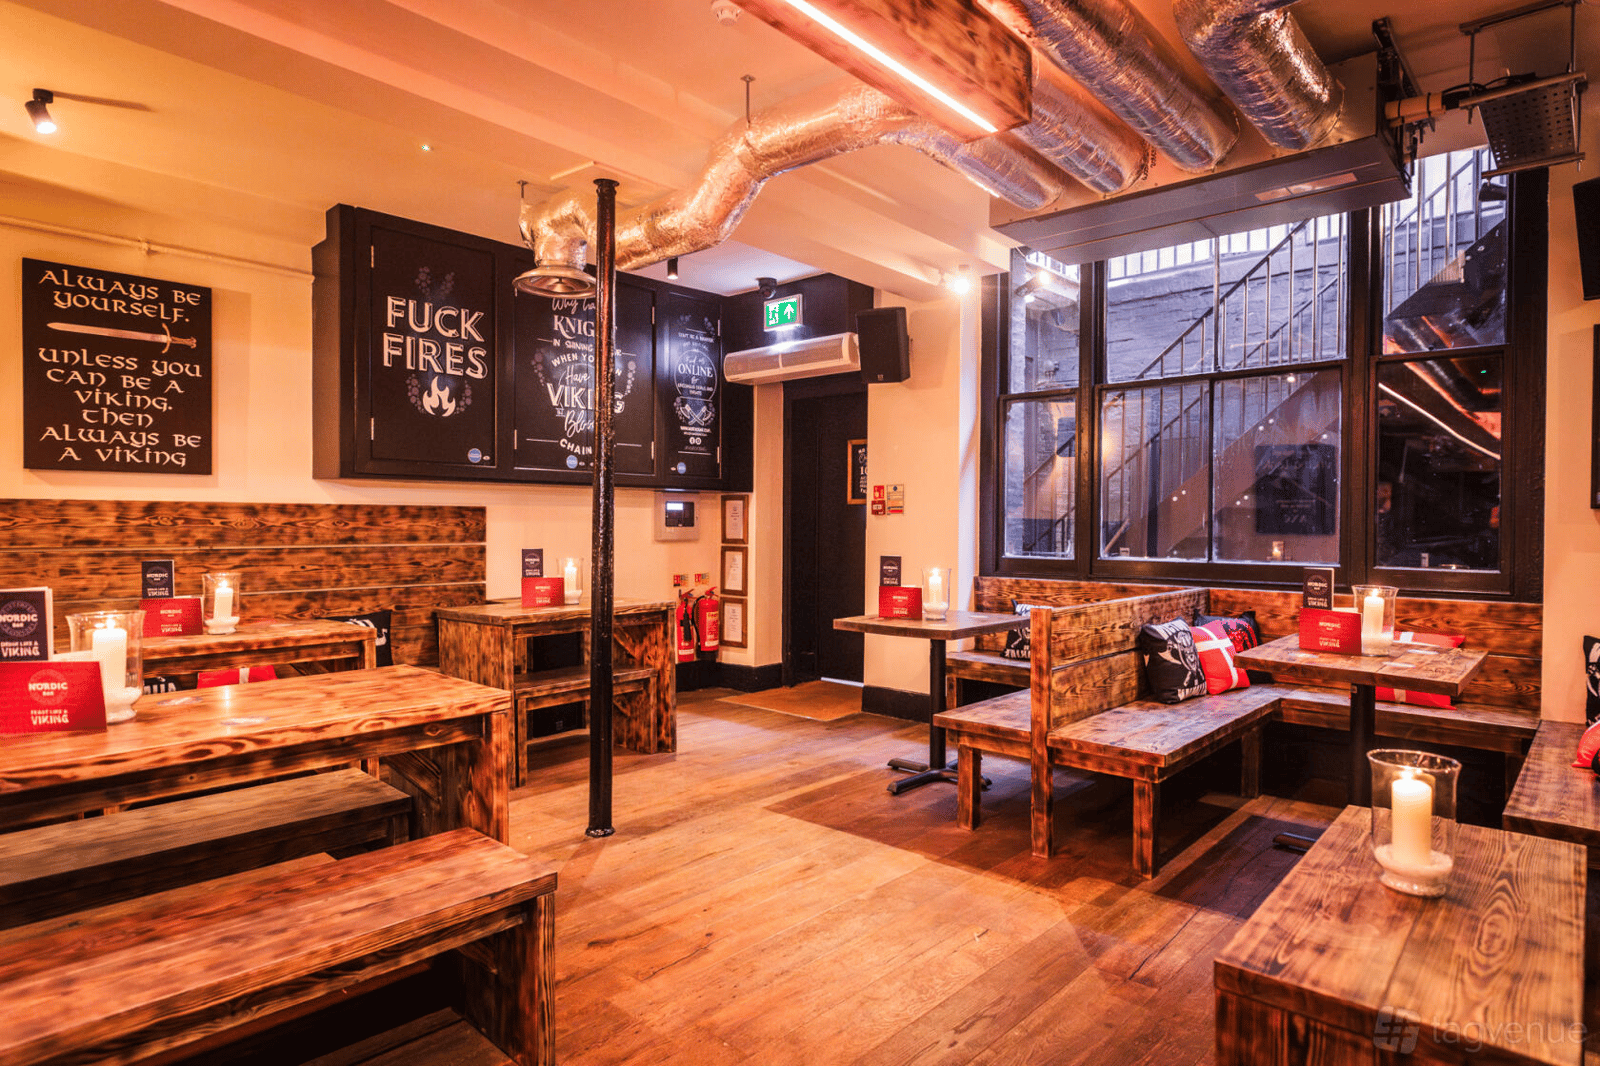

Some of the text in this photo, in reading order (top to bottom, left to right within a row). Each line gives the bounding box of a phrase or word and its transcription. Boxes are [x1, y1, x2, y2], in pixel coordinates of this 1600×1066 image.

[172, 289, 201, 306] BE
[387, 295, 485, 342] FUCK
[553, 314, 595, 340] KNIG
[383, 332, 489, 380] FIRES
[551, 352, 595, 368] WHEN YO
[678, 362, 714, 378] ONLINE
[121, 374, 152, 390] BE
[164, 380, 185, 394] A
[172, 434, 202, 448] BE
[58, 447, 82, 462] A
[0, 613, 38, 622] NORDIC
[1, 646, 40, 658] VIKING
[28, 682, 68, 691] NORDIC
[30, 714, 69, 726] VIKING
